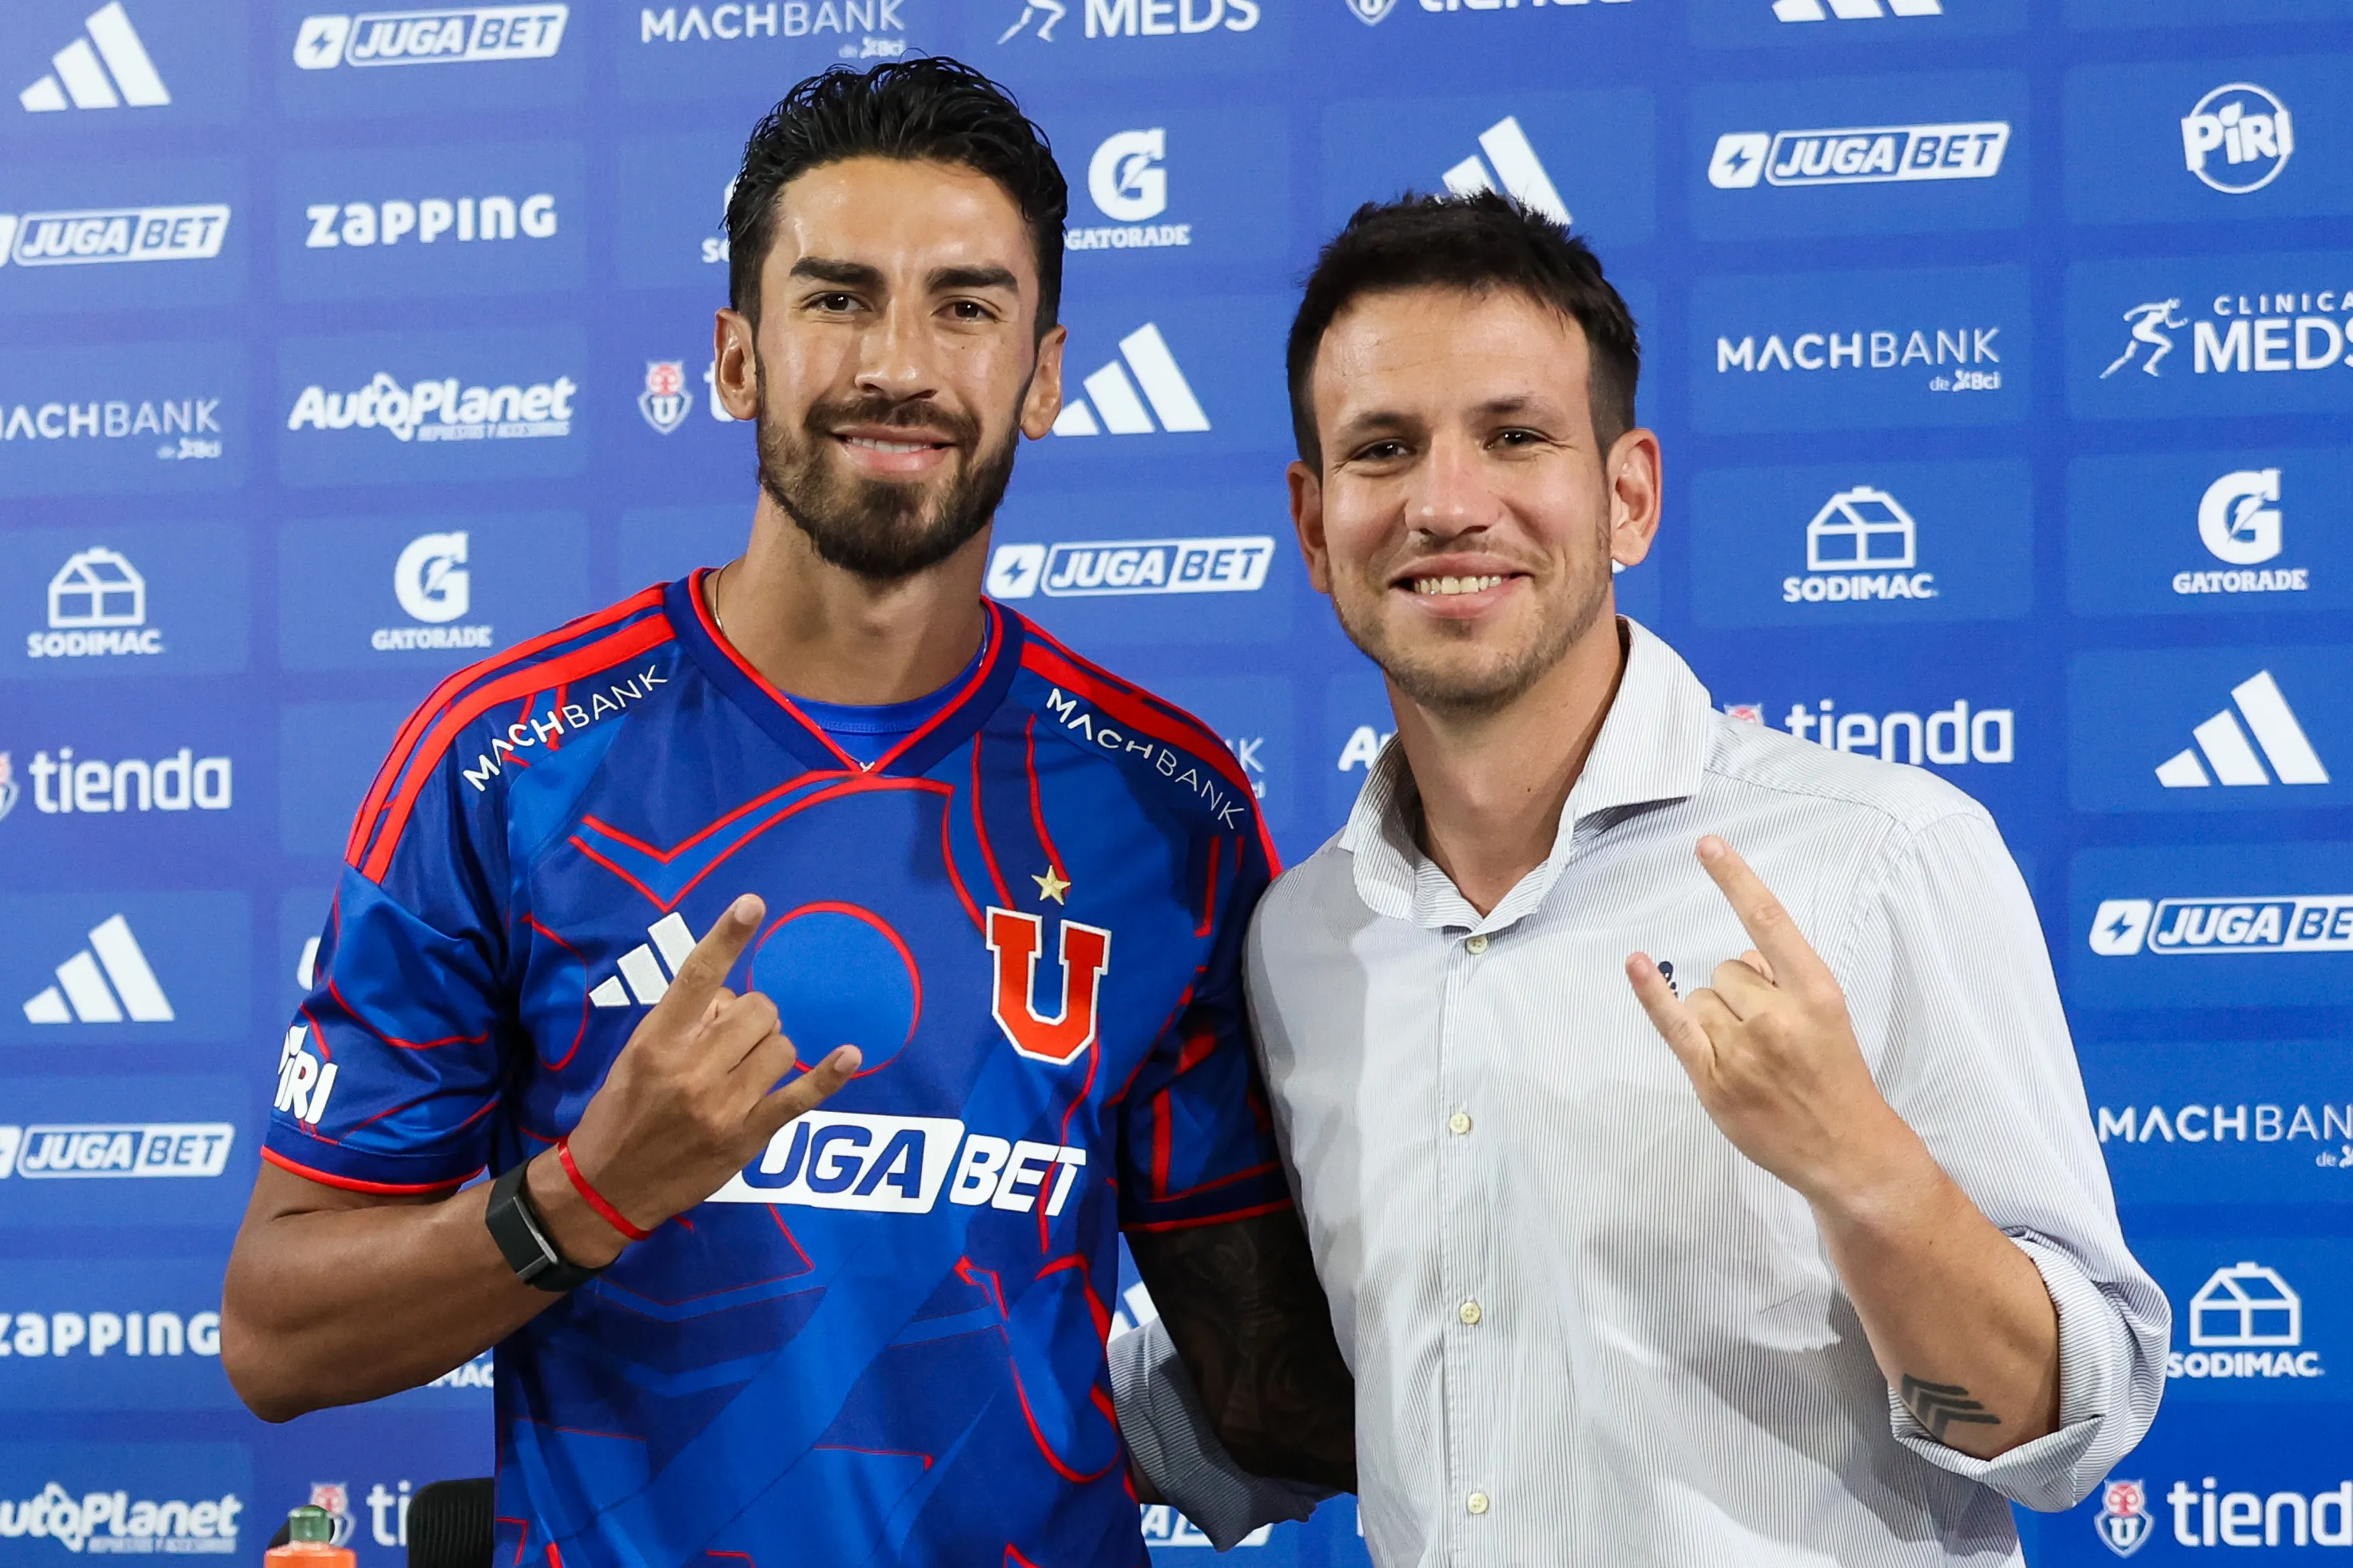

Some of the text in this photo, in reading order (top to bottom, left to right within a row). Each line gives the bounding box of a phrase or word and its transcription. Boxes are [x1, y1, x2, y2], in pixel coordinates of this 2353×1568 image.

[641, 0, 905, 43] MACHBANK
[1085, 0, 1260, 38] MEDS
[1064, 224, 1191, 250] GATORADE
[1717, 328, 2000, 373] MACHBANK
[2194, 317, 2353, 374] MED
[0, 399, 220, 440] ACHBANK
[1783, 574, 1935, 602] SODIMAC
[2172, 569, 2308, 594] GATORADE
[27, 629, 162, 657] SODIMAC
[371, 627, 492, 649] GATORADE
[463, 665, 668, 792] MACHBANK
[1785, 699, 2013, 764] tienda
[1046, 688, 1245, 829] MACHBANK
[29, 746, 232, 813] tienda
[2167, 1352, 2319, 1379] SODIMAC
